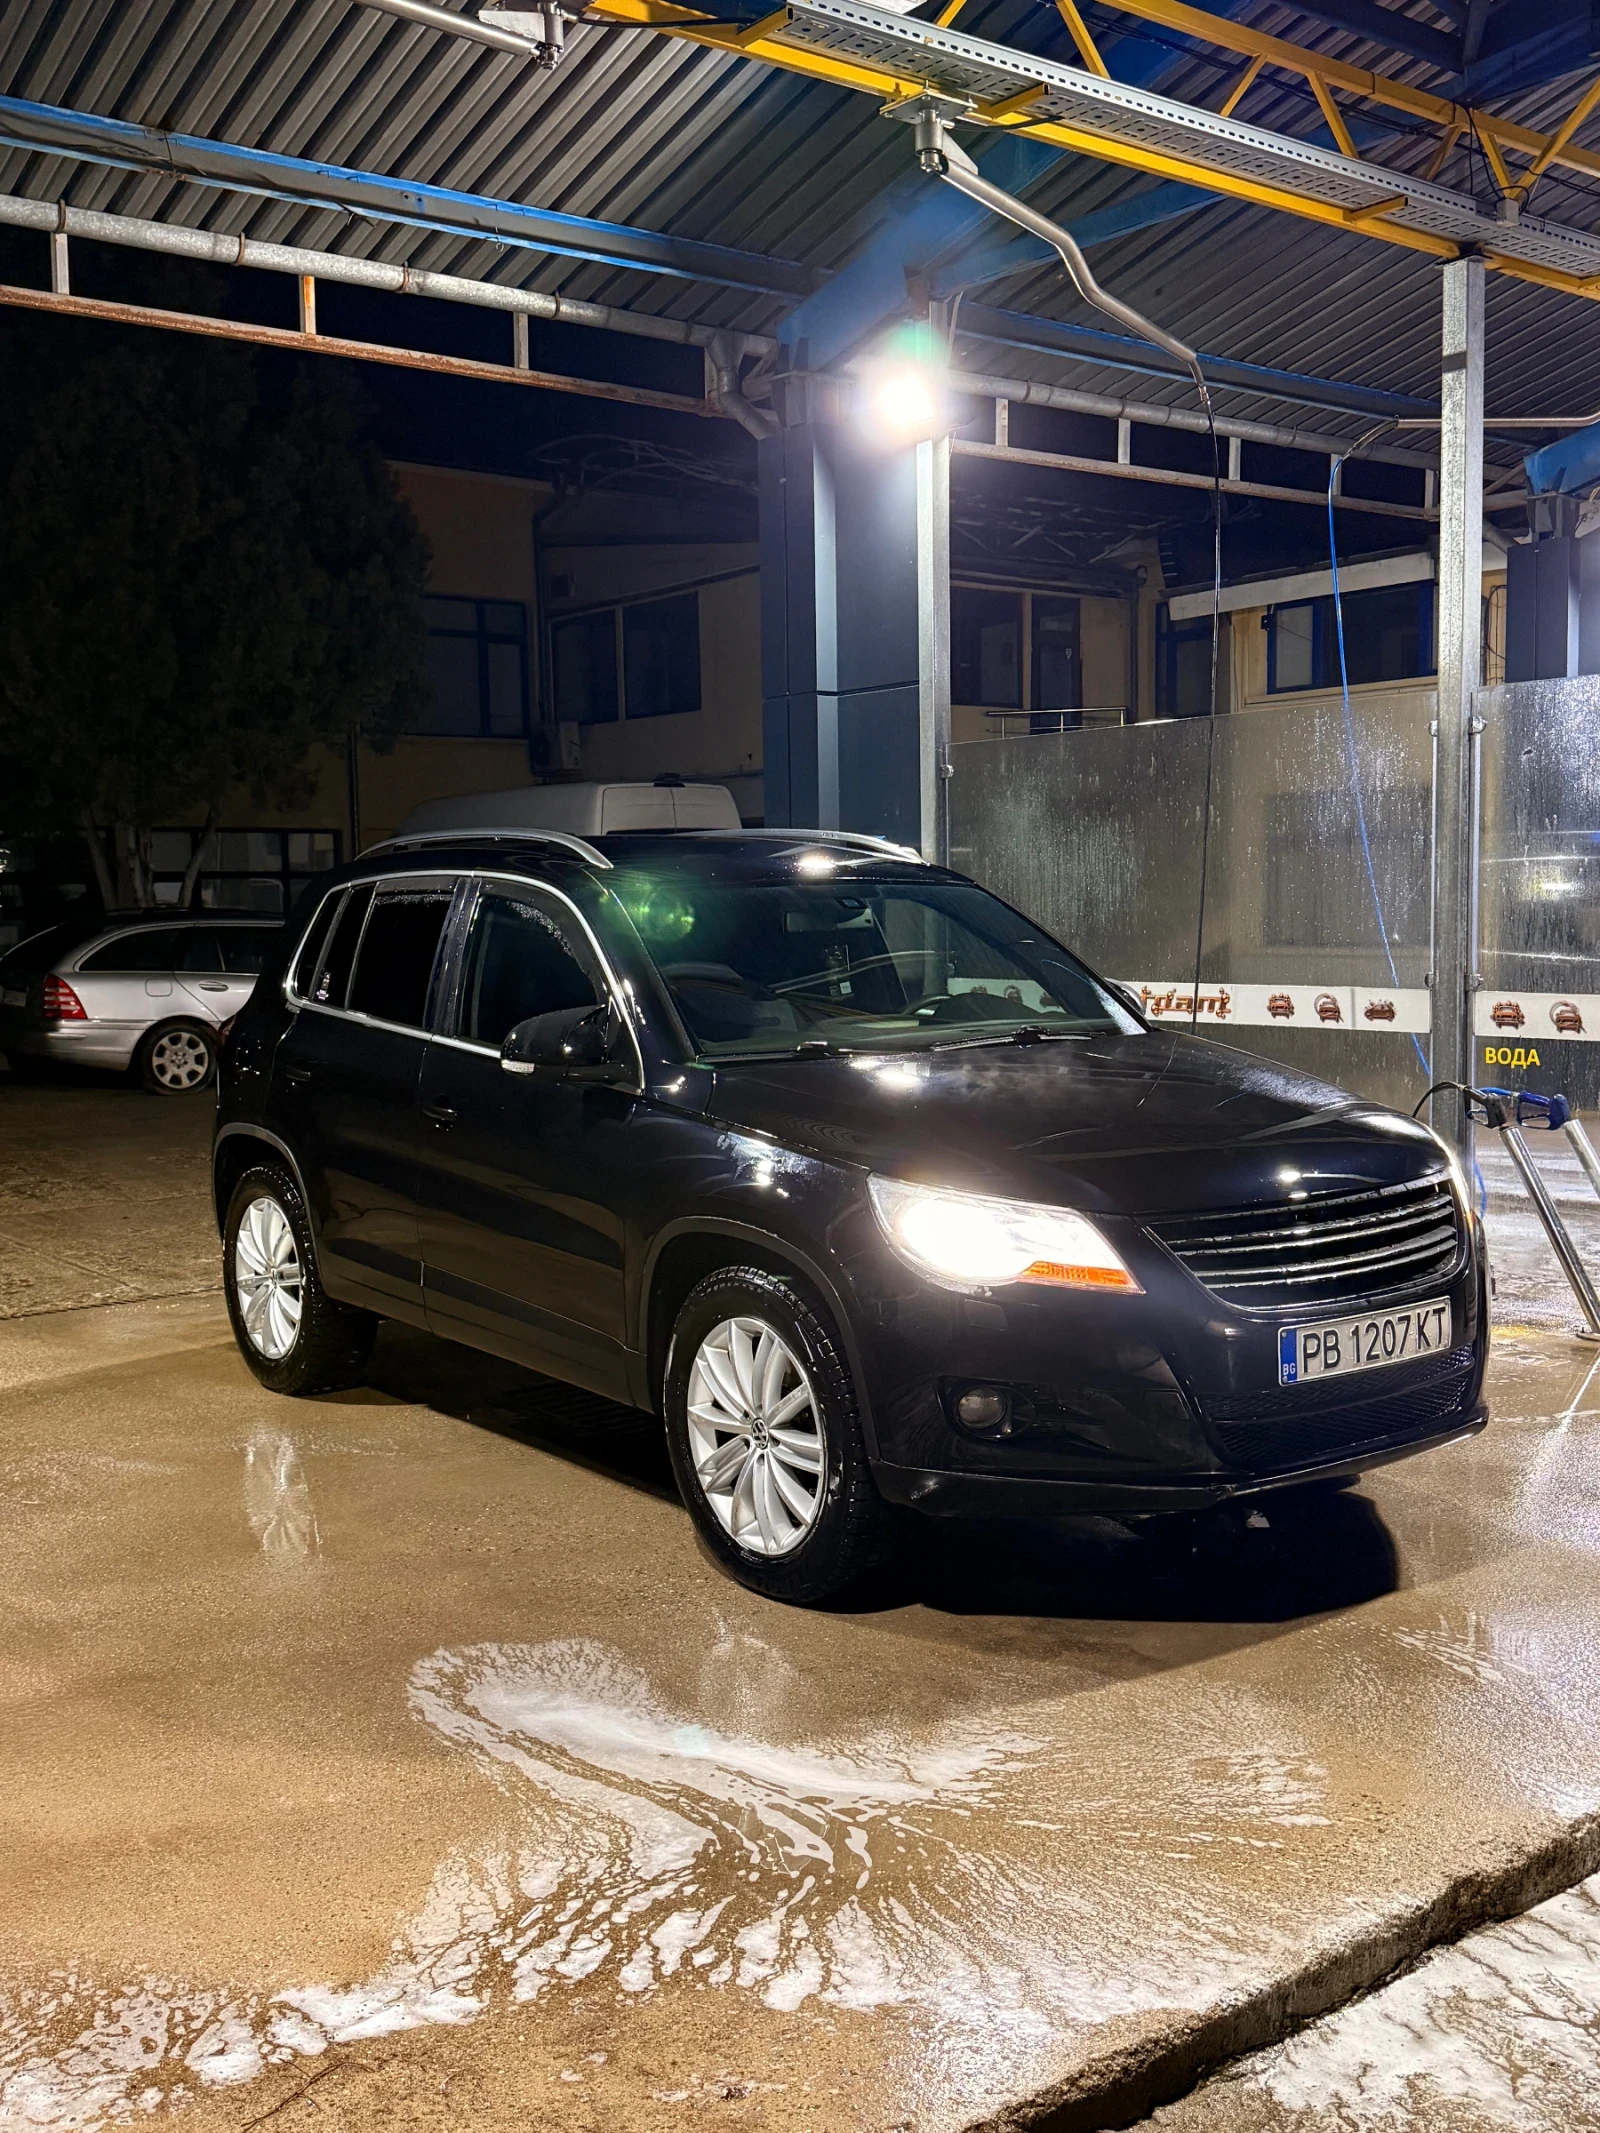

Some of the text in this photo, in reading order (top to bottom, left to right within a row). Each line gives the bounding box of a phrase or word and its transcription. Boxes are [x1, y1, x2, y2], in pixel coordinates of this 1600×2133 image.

[1485, 1046, 1541, 1070] ВОДА
[1302, 1306, 1446, 1374] PB 1207 KT
[1283, 1362, 1296, 1375] BG
